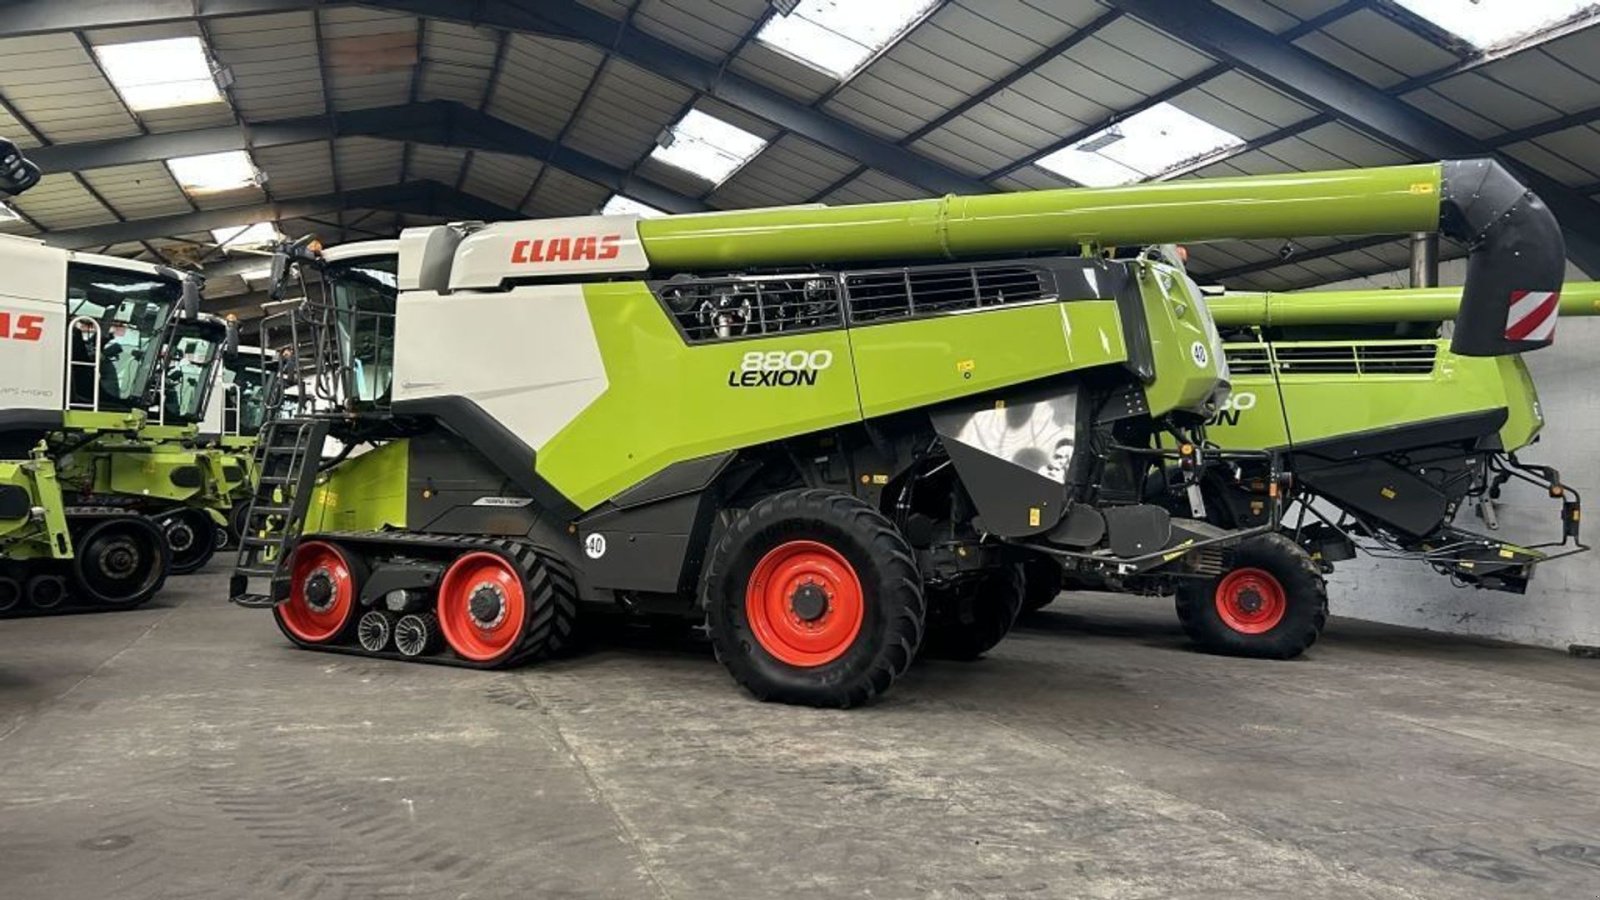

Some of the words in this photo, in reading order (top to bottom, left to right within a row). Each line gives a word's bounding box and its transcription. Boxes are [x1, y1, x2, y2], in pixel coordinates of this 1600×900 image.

[511, 235, 621, 263] CLAAS
[741, 350, 833, 371] 8800
[728, 369, 818, 387] LEXION
[588, 537, 603, 554] 40
